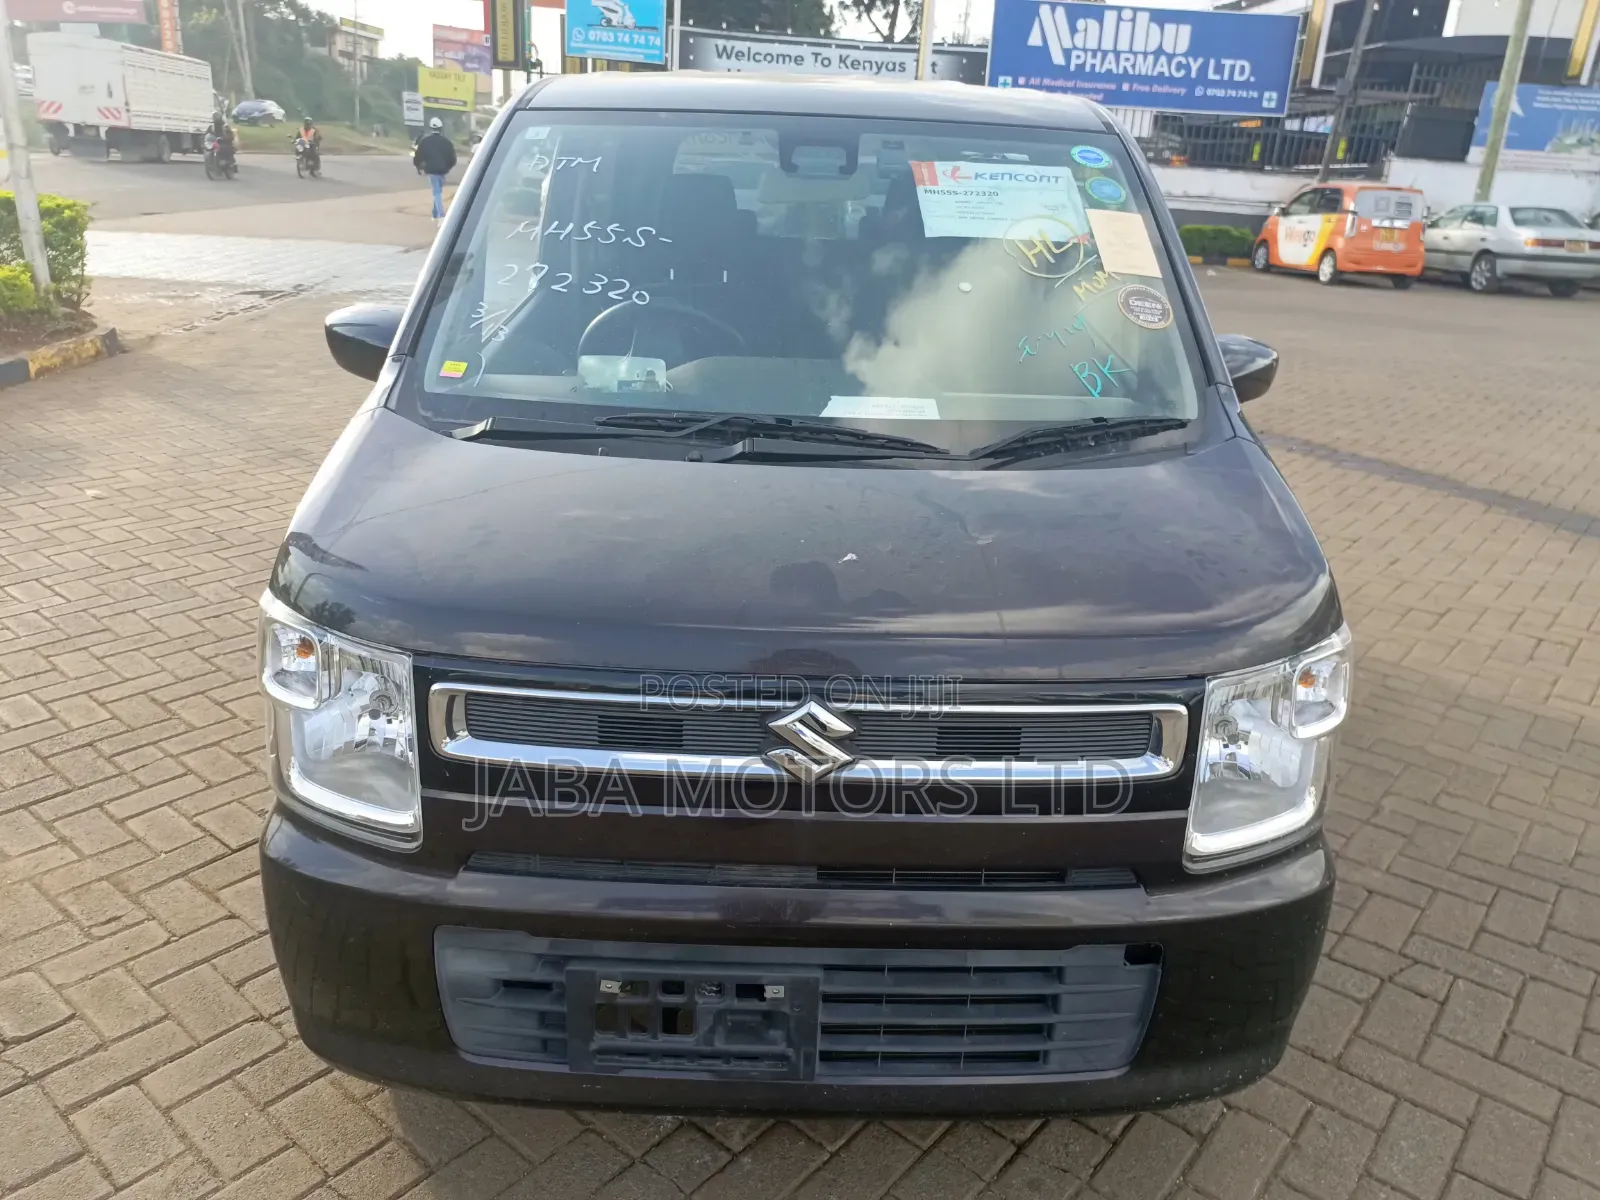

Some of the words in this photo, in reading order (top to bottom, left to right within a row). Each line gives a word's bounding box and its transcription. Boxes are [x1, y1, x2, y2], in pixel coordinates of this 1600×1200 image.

[616, 32, 631, 44] 74
[632, 34, 646, 46] 74
[647, 35, 661, 47] 74
[1027, 3, 1192, 65] Malibu
[715, 43, 805, 67] Welcome
[811, 52, 831, 68] To
[839, 54, 907, 75] Kenyas
[1069, 50, 1204, 79] PHARMACY
[1207, 58, 1256, 82] LTD.
[1029, 76, 1041, 86] All
[1042, 77, 1075, 88] Medical
[1076, 80, 1117, 91] Insurance
[1132, 83, 1151, 93] Free
[1152, 84, 1187, 96] Delivery
[923, 187, 999, 198] MH55S-272320
[506, 220, 673, 247] MH55S-
[497, 261, 650, 305] 272320
[1070, 354, 1131, 398] BK
